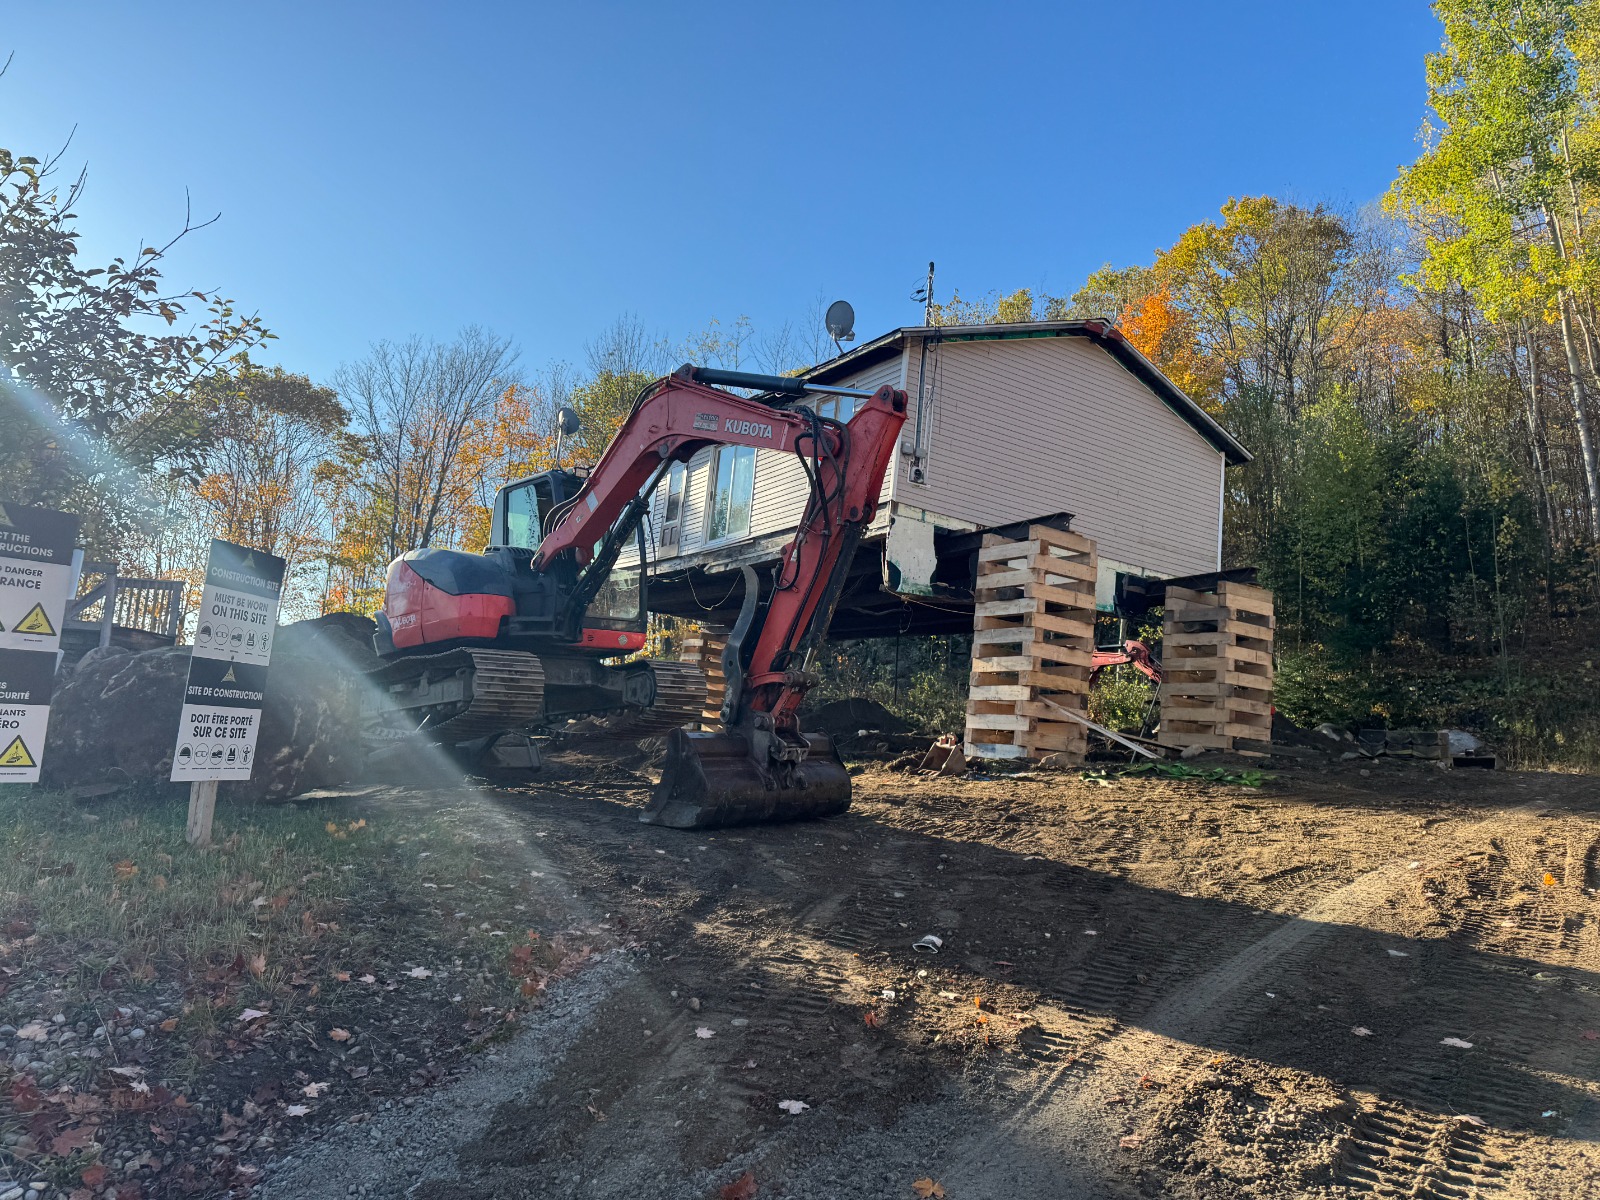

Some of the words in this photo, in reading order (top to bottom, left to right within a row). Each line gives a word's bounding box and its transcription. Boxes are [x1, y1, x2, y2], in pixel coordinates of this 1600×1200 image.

[724, 418, 773, 439] KUBOTA
[11, 532, 30, 543] THE
[0, 542, 54, 557] RUCTIONS
[4, 565, 43, 577] DANGER
[0, 576, 42, 590] RANCE
[211, 566, 266, 589] CONSTRUCTION
[266, 580, 279, 592] SITE
[214, 592, 235, 605] MUST
[236, 597, 245, 607] BE
[247, 600, 269, 613] WORN
[212, 604, 228, 618] ON
[229, 607, 249, 622] THIS
[250, 611, 267, 625] SITE
[0, 690, 30, 700] CURITÉ
[187, 685, 203, 696] SITE
[203, 686, 213, 696] DE
[213, 688, 263, 701] CONSTRUCTION
[190, 713, 211, 724] DOIT
[211, 712, 229, 725] ÊTRE
[229, 714, 253, 726] PORTÉ
[192, 726, 212, 738] SUR
[214, 726, 227, 738] CE
[229, 727, 247, 739] SITE
